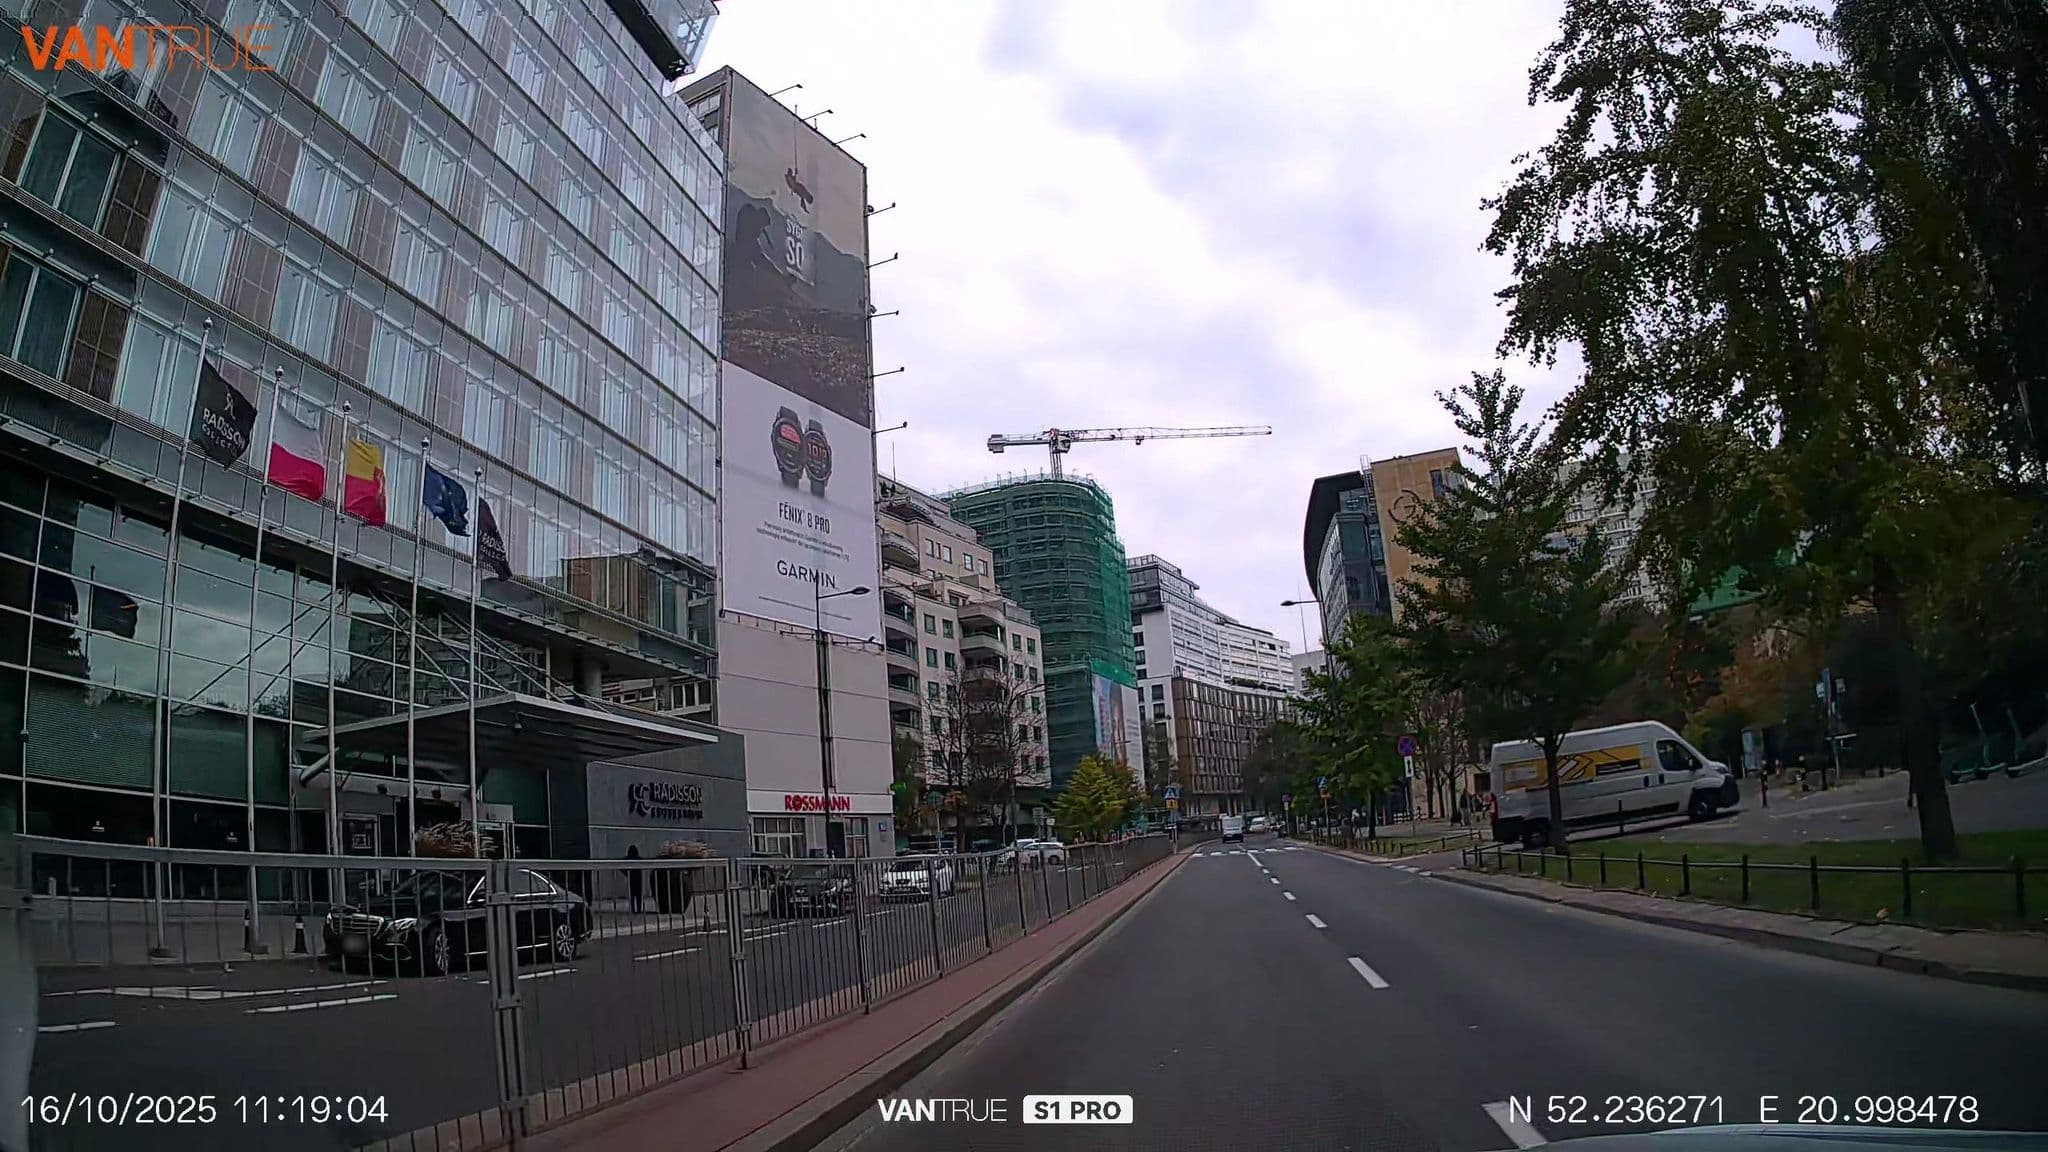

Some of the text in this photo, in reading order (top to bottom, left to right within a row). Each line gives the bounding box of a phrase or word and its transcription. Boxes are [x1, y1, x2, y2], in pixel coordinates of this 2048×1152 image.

[807, 512, 813, 528] 8
[814, 514, 830, 534] PRO
[776, 559, 837, 589] GARMIN
[652, 782, 703, 804] RADISSON
